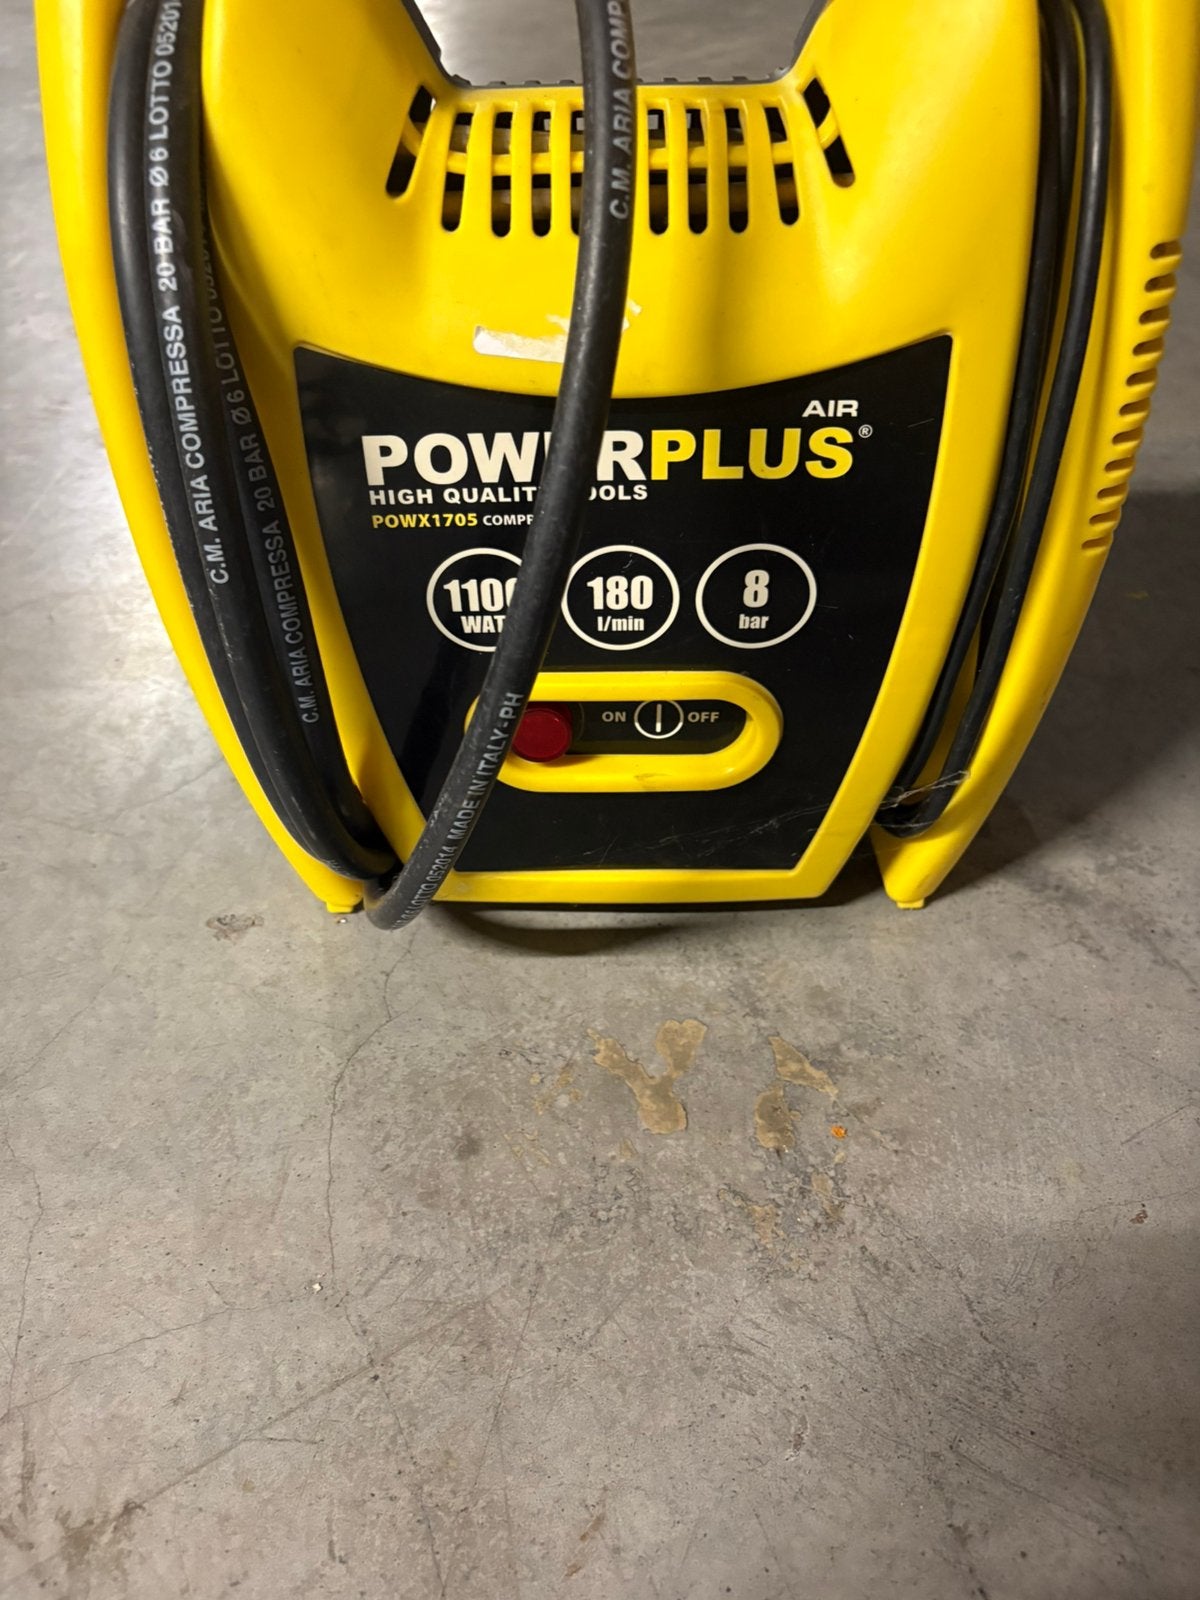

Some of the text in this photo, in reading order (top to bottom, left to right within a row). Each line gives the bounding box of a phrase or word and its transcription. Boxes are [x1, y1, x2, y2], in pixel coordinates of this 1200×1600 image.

[149, 60, 172, 140] LOTTO
[612, 87, 633, 156] ARIA
[150, 147, 169, 162] 6
[608, 163, 632, 220] C.M.
[150, 198, 175, 255] BAR
[157, 262, 178, 292] 20
[162, 305, 202, 471] COMPRESSA
[226, 389, 245, 404] 6
[802, 400, 859, 417] AIR
[240, 432, 270, 483] BAR
[188, 474, 219, 532] ARIA
[257, 486, 277, 512] 20
[369, 488, 433, 505] HIGH
[443, 486, 538, 505] QUALIT
[371, 513, 478, 528] POWX1705
[202, 538, 230, 586] C.M.
[264, 519, 306, 644] COMPRESSA
[587, 575, 653, 611] 180
[742, 569, 770, 608] 8
[460, 615, 506, 634] WAT
[738, 613, 769, 630] bar
[289, 645, 312, 692] ARIA
[297, 686, 319, 724] C.M.
[601, 711, 627, 724] ON
[687, 711, 720, 724] OFF
[426, 846, 458, 881] 052014
[446, 799, 481, 840] MADE
[467, 778, 486, 797] IN
